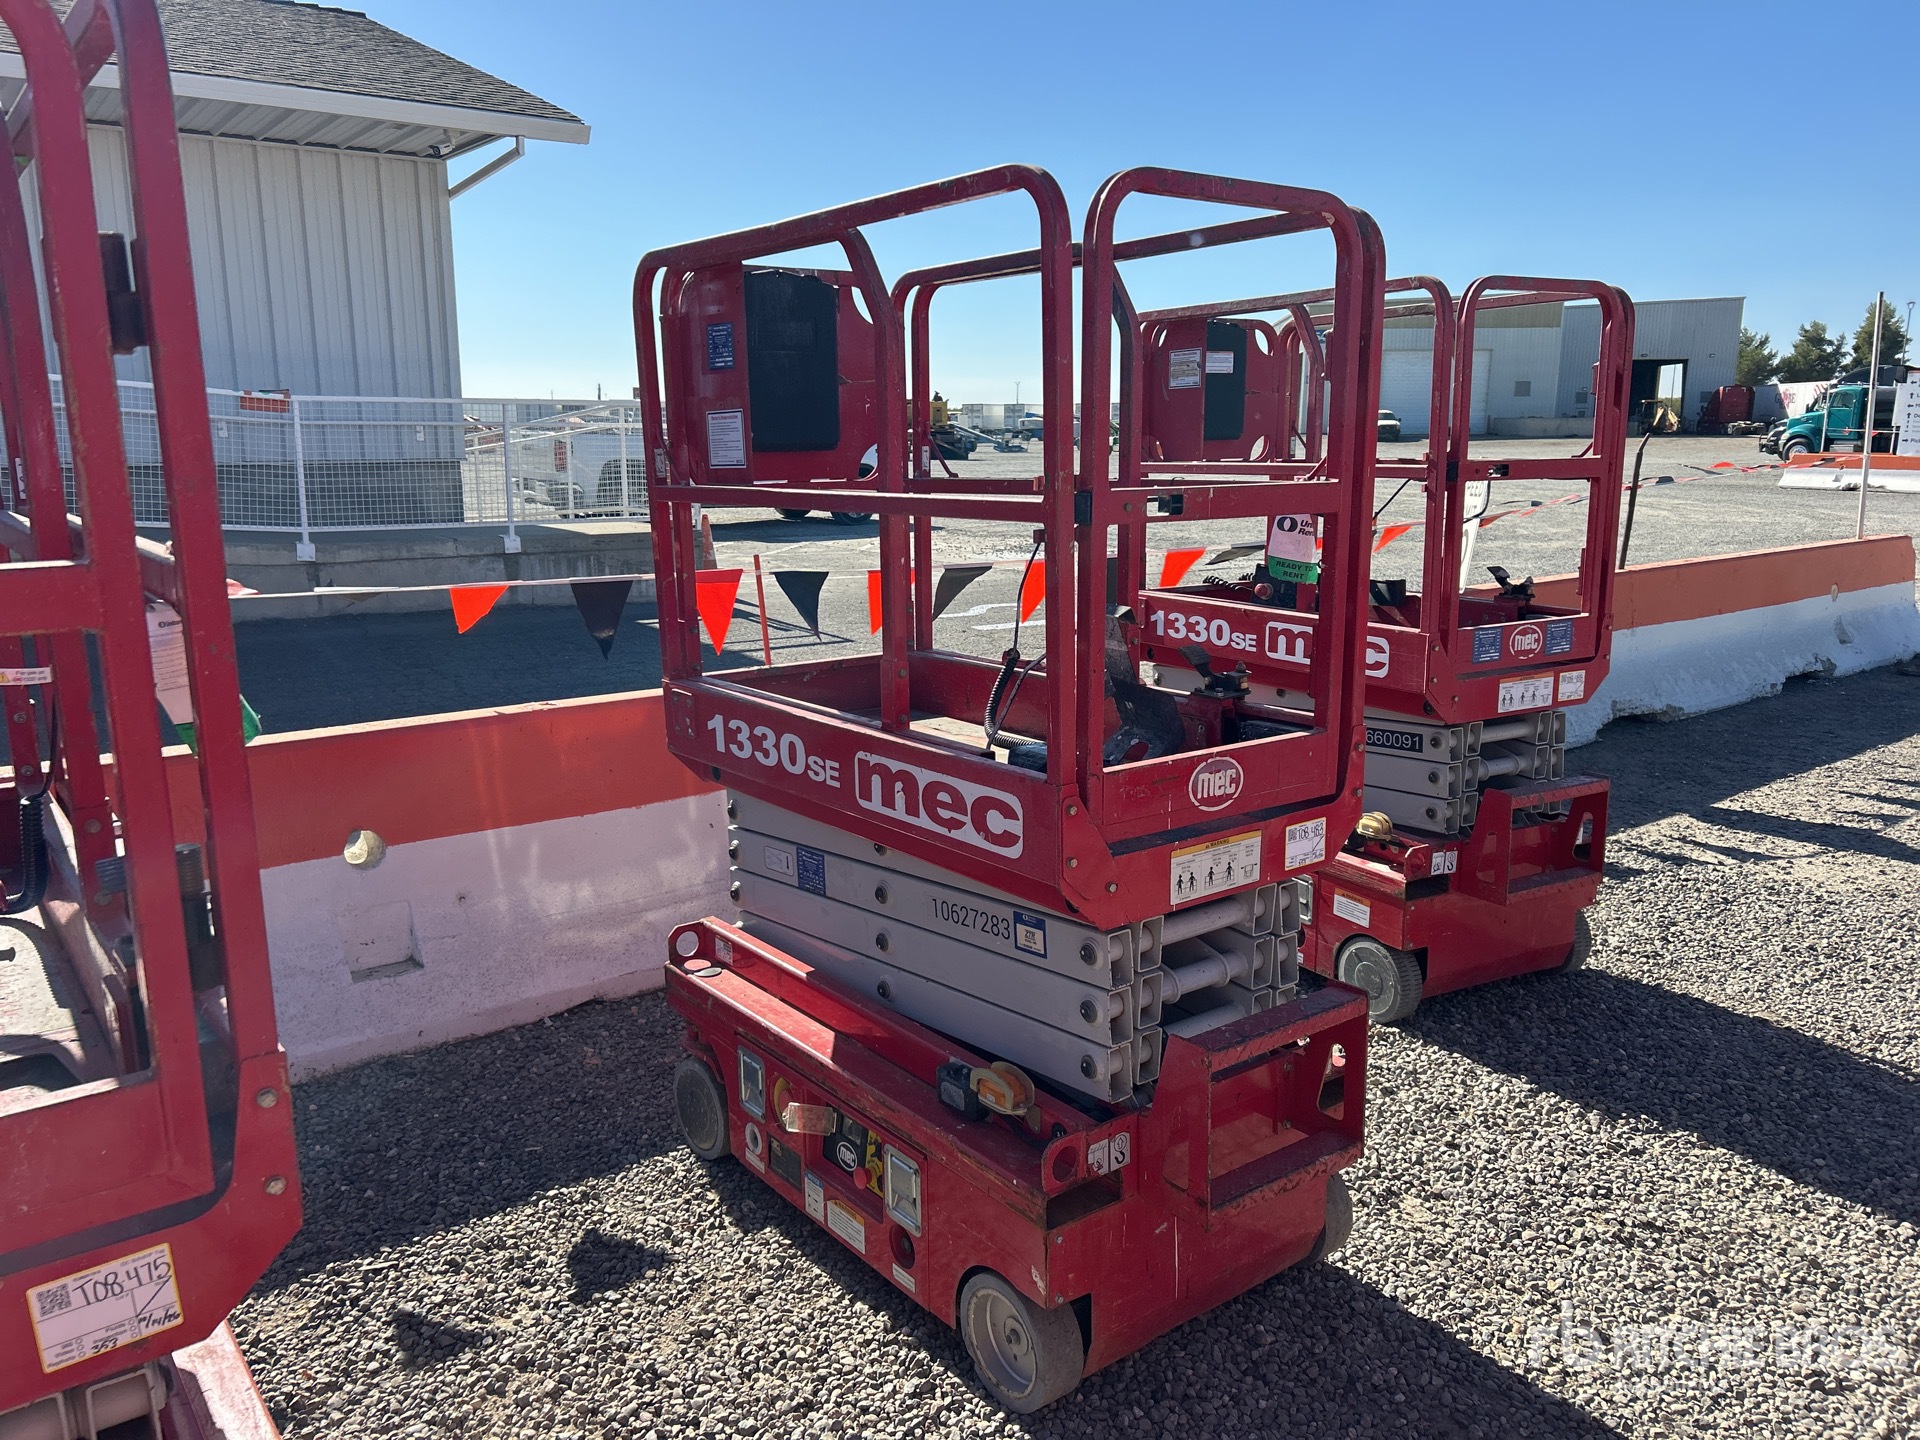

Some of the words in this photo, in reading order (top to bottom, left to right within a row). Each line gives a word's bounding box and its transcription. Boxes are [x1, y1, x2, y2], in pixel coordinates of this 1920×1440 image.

[1276, 560, 1302, 571] READY
[1283, 570, 1304, 579] RENT
[1150, 610, 1257, 652] 1330SE
[707, 714, 841, 788] 1330SE
[857, 756, 1022, 849] mec
[1196, 768, 1237, 799] mec
[931, 898, 1011, 940] 10627283
[840, 1146, 855, 1167] mec
